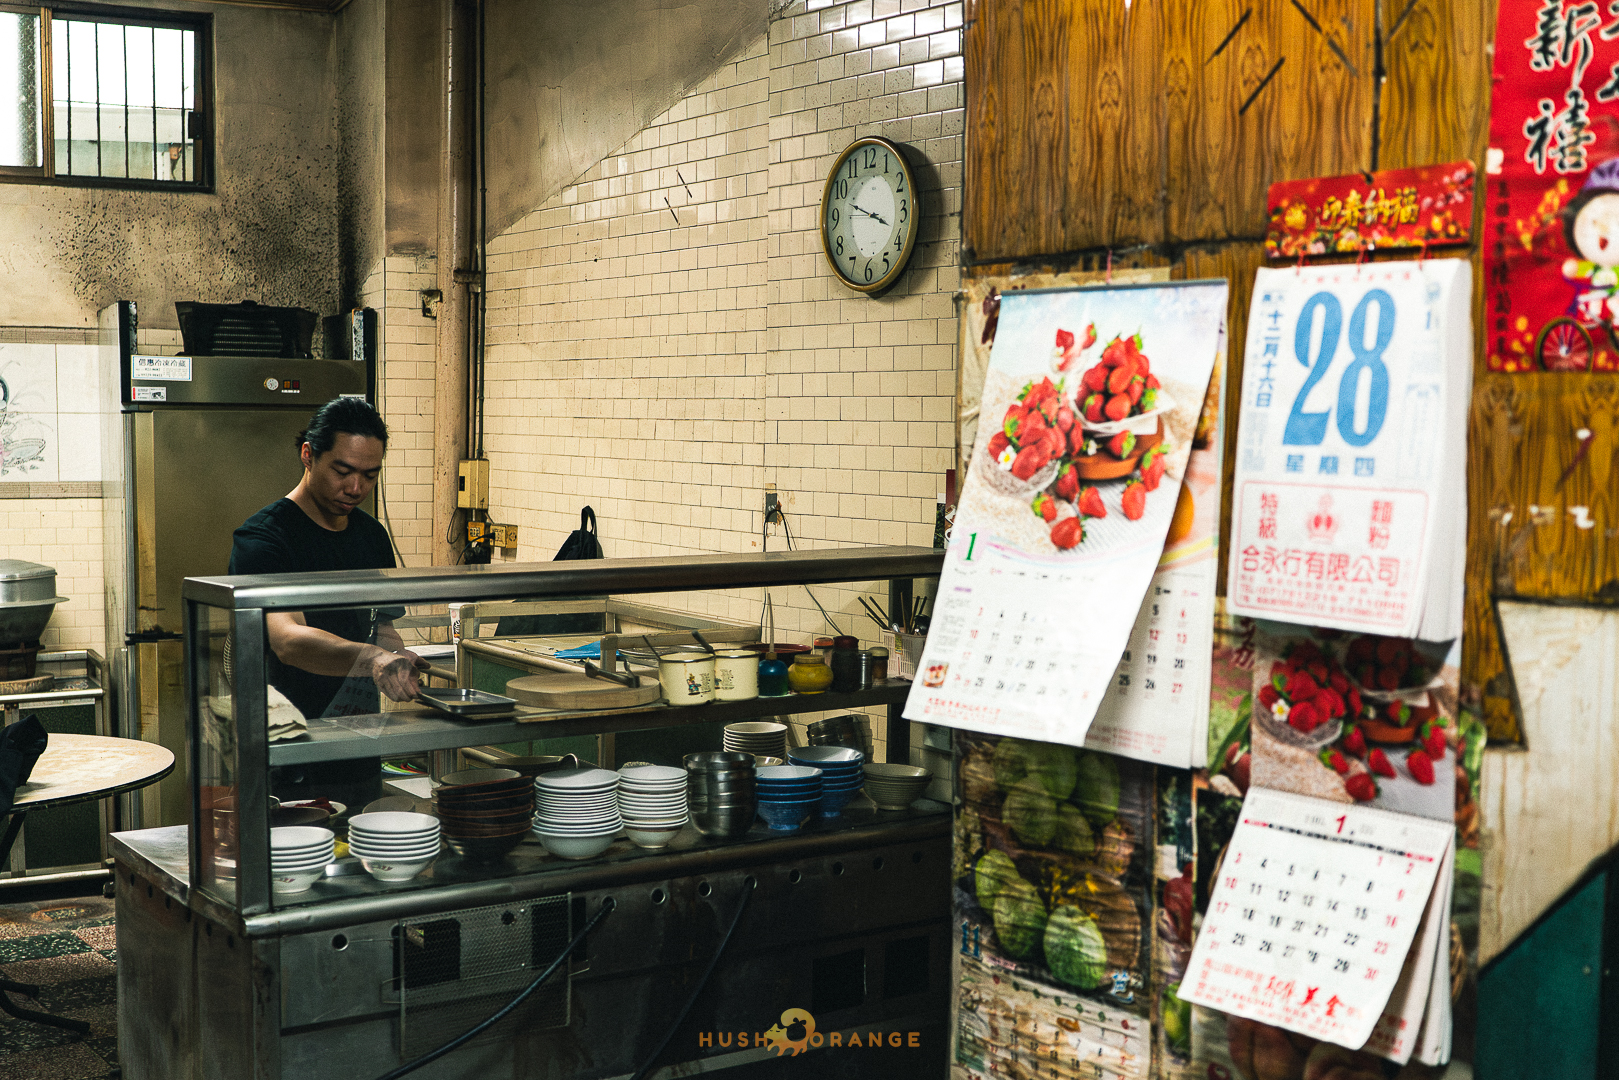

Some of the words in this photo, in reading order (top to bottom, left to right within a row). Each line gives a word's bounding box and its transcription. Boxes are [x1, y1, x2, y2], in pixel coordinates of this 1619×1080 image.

[1526, 0, 1600, 174] 新禧
[848, 158, 858, 179] 11
[864, 148, 876, 169] 12
[883, 153, 889, 174] 1
[835, 179, 848, 200] 10
[896, 172, 903, 193] 2
[832, 208, 840, 231] 9
[900, 200, 907, 223] 3
[836, 236, 843, 256] 8
[894, 228, 902, 251] 4
[849, 256, 856, 277] 7
[864, 258, 873, 281] 6
[882, 252, 890, 274] 5
[1256, 310, 1283, 407] 十二月十六日
[1283, 288, 1396, 447] 28
[965, 532, 977, 561] 1
[1335, 815, 1347, 834] 1
[960, 921, 982, 962] 11
[1343, 933, 1360, 946] 22
[1232, 933, 1246, 946] 25
[1334, 959, 1350, 973] 29
